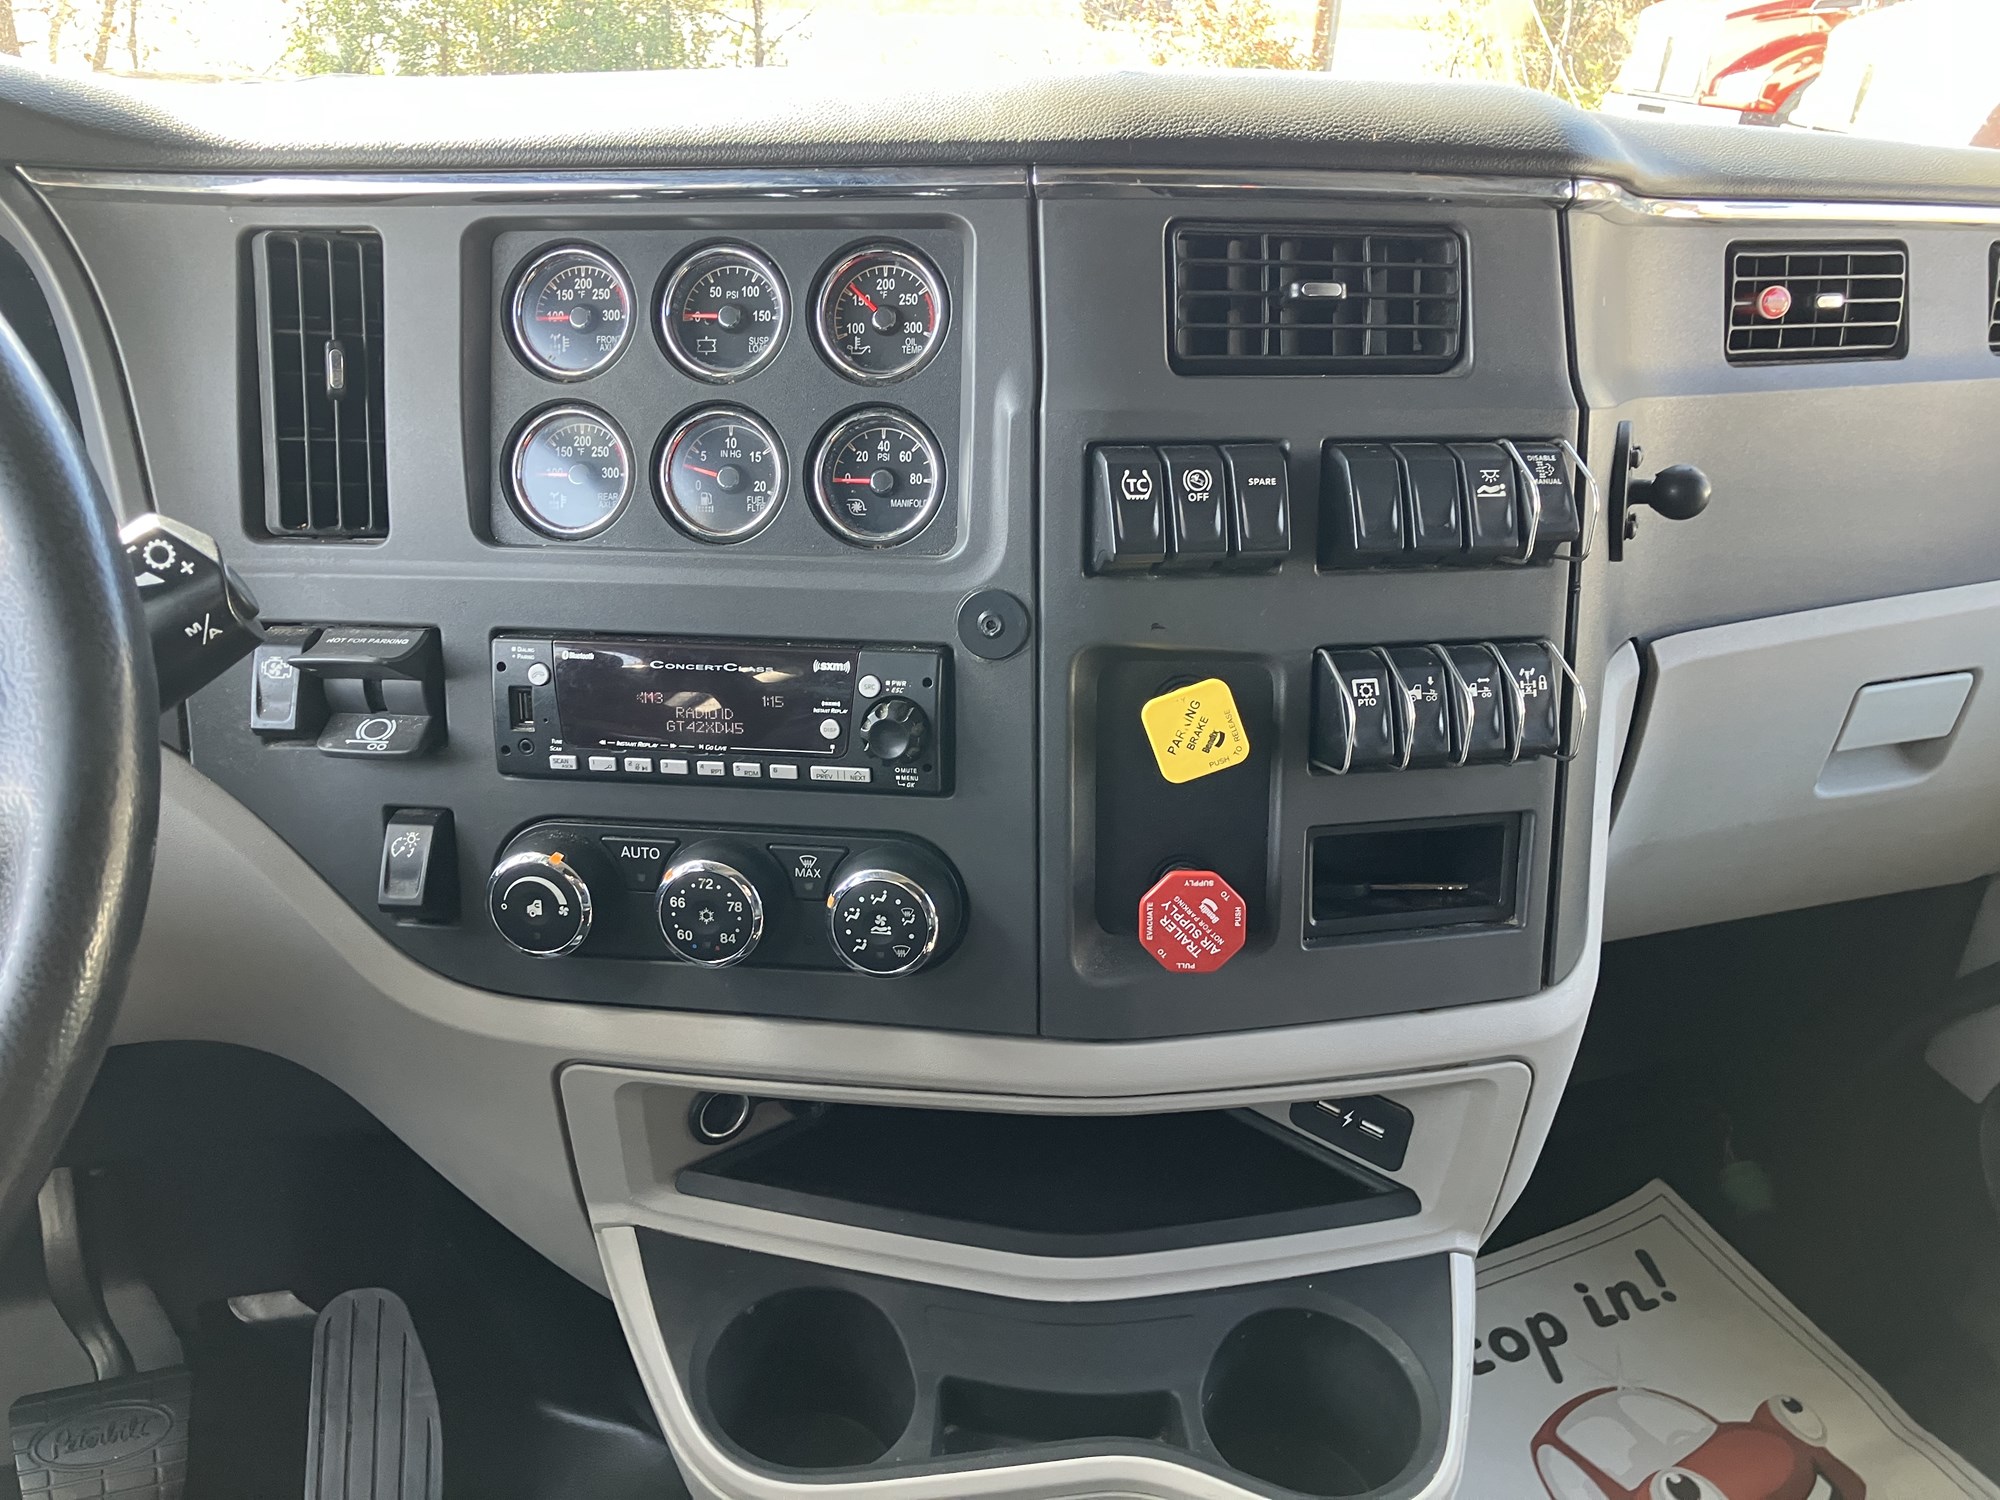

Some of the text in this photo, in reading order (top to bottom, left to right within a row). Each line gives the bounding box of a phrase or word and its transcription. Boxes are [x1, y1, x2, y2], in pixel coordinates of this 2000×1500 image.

[574, 278, 592, 289] 200
[876, 279, 895, 290] 200
[556, 290, 573, 300] 150
[592, 289, 610, 300] 250
[709, 286, 722, 298] 50
[726, 291, 739, 299] PSI
[741, 286, 760, 297] 100
[899, 293, 918, 305] 250
[602, 309, 620, 321] 300
[752, 310, 771, 321] 150
[847, 322, 865, 334] 100
[903, 321, 922, 334] 300
[748, 336, 769, 345] SUSP
[905, 338, 916, 346] OIL
[902, 345, 923, 354] TEMP
[573, 435, 591, 447] 200
[725, 437, 737, 448] 10
[877, 440, 890, 451] 40
[556, 446, 572, 457] 150
[591, 446, 609, 457] 250
[700, 451, 707, 461] 5
[720, 450, 742, 458] IN HG
[749, 451, 762, 462] 15
[856, 451, 869, 462] 20
[877, 453, 890, 461] PSI
[899, 451, 912, 462] 60
[601, 467, 620, 478] 300
[909, 473, 922, 485] 80
[1248, 478, 1277, 486] SPARE
[695, 480, 701, 490] 0
[754, 481, 766, 492] 20
[1126, 479, 1147, 492] TC
[747, 495, 766, 504] FUEL
[1188, 492, 1210, 502] OFF
[762, 696, 784, 708] 1:15
[1358, 699, 1377, 707] PTO
[720, 708, 734, 720] ID
[1186, 716, 1209, 751] BRAKE
[1208, 756, 1230, 768] PUSH
[620, 846, 660, 860] AUTO
[794, 867, 821, 878] MAX
[698, 878, 714, 890] 72
[1184, 879, 1214, 887] SUPPLY
[669, 896, 686, 908] 66
[1220, 891, 1230, 902] TO
[727, 901, 743, 913] 78
[1173, 896, 1225, 945] NOT FOR PARKING
[1161, 900, 1221, 955] AIR SUPPLY
[677, 929, 693, 941] 60
[720, 932, 736, 944] 84
[1146, 902, 1196, 970] PULL TO EVACUATE
[1159, 915, 1202, 959] TRAILER
[1574, 1249, 1677, 1328] in!
